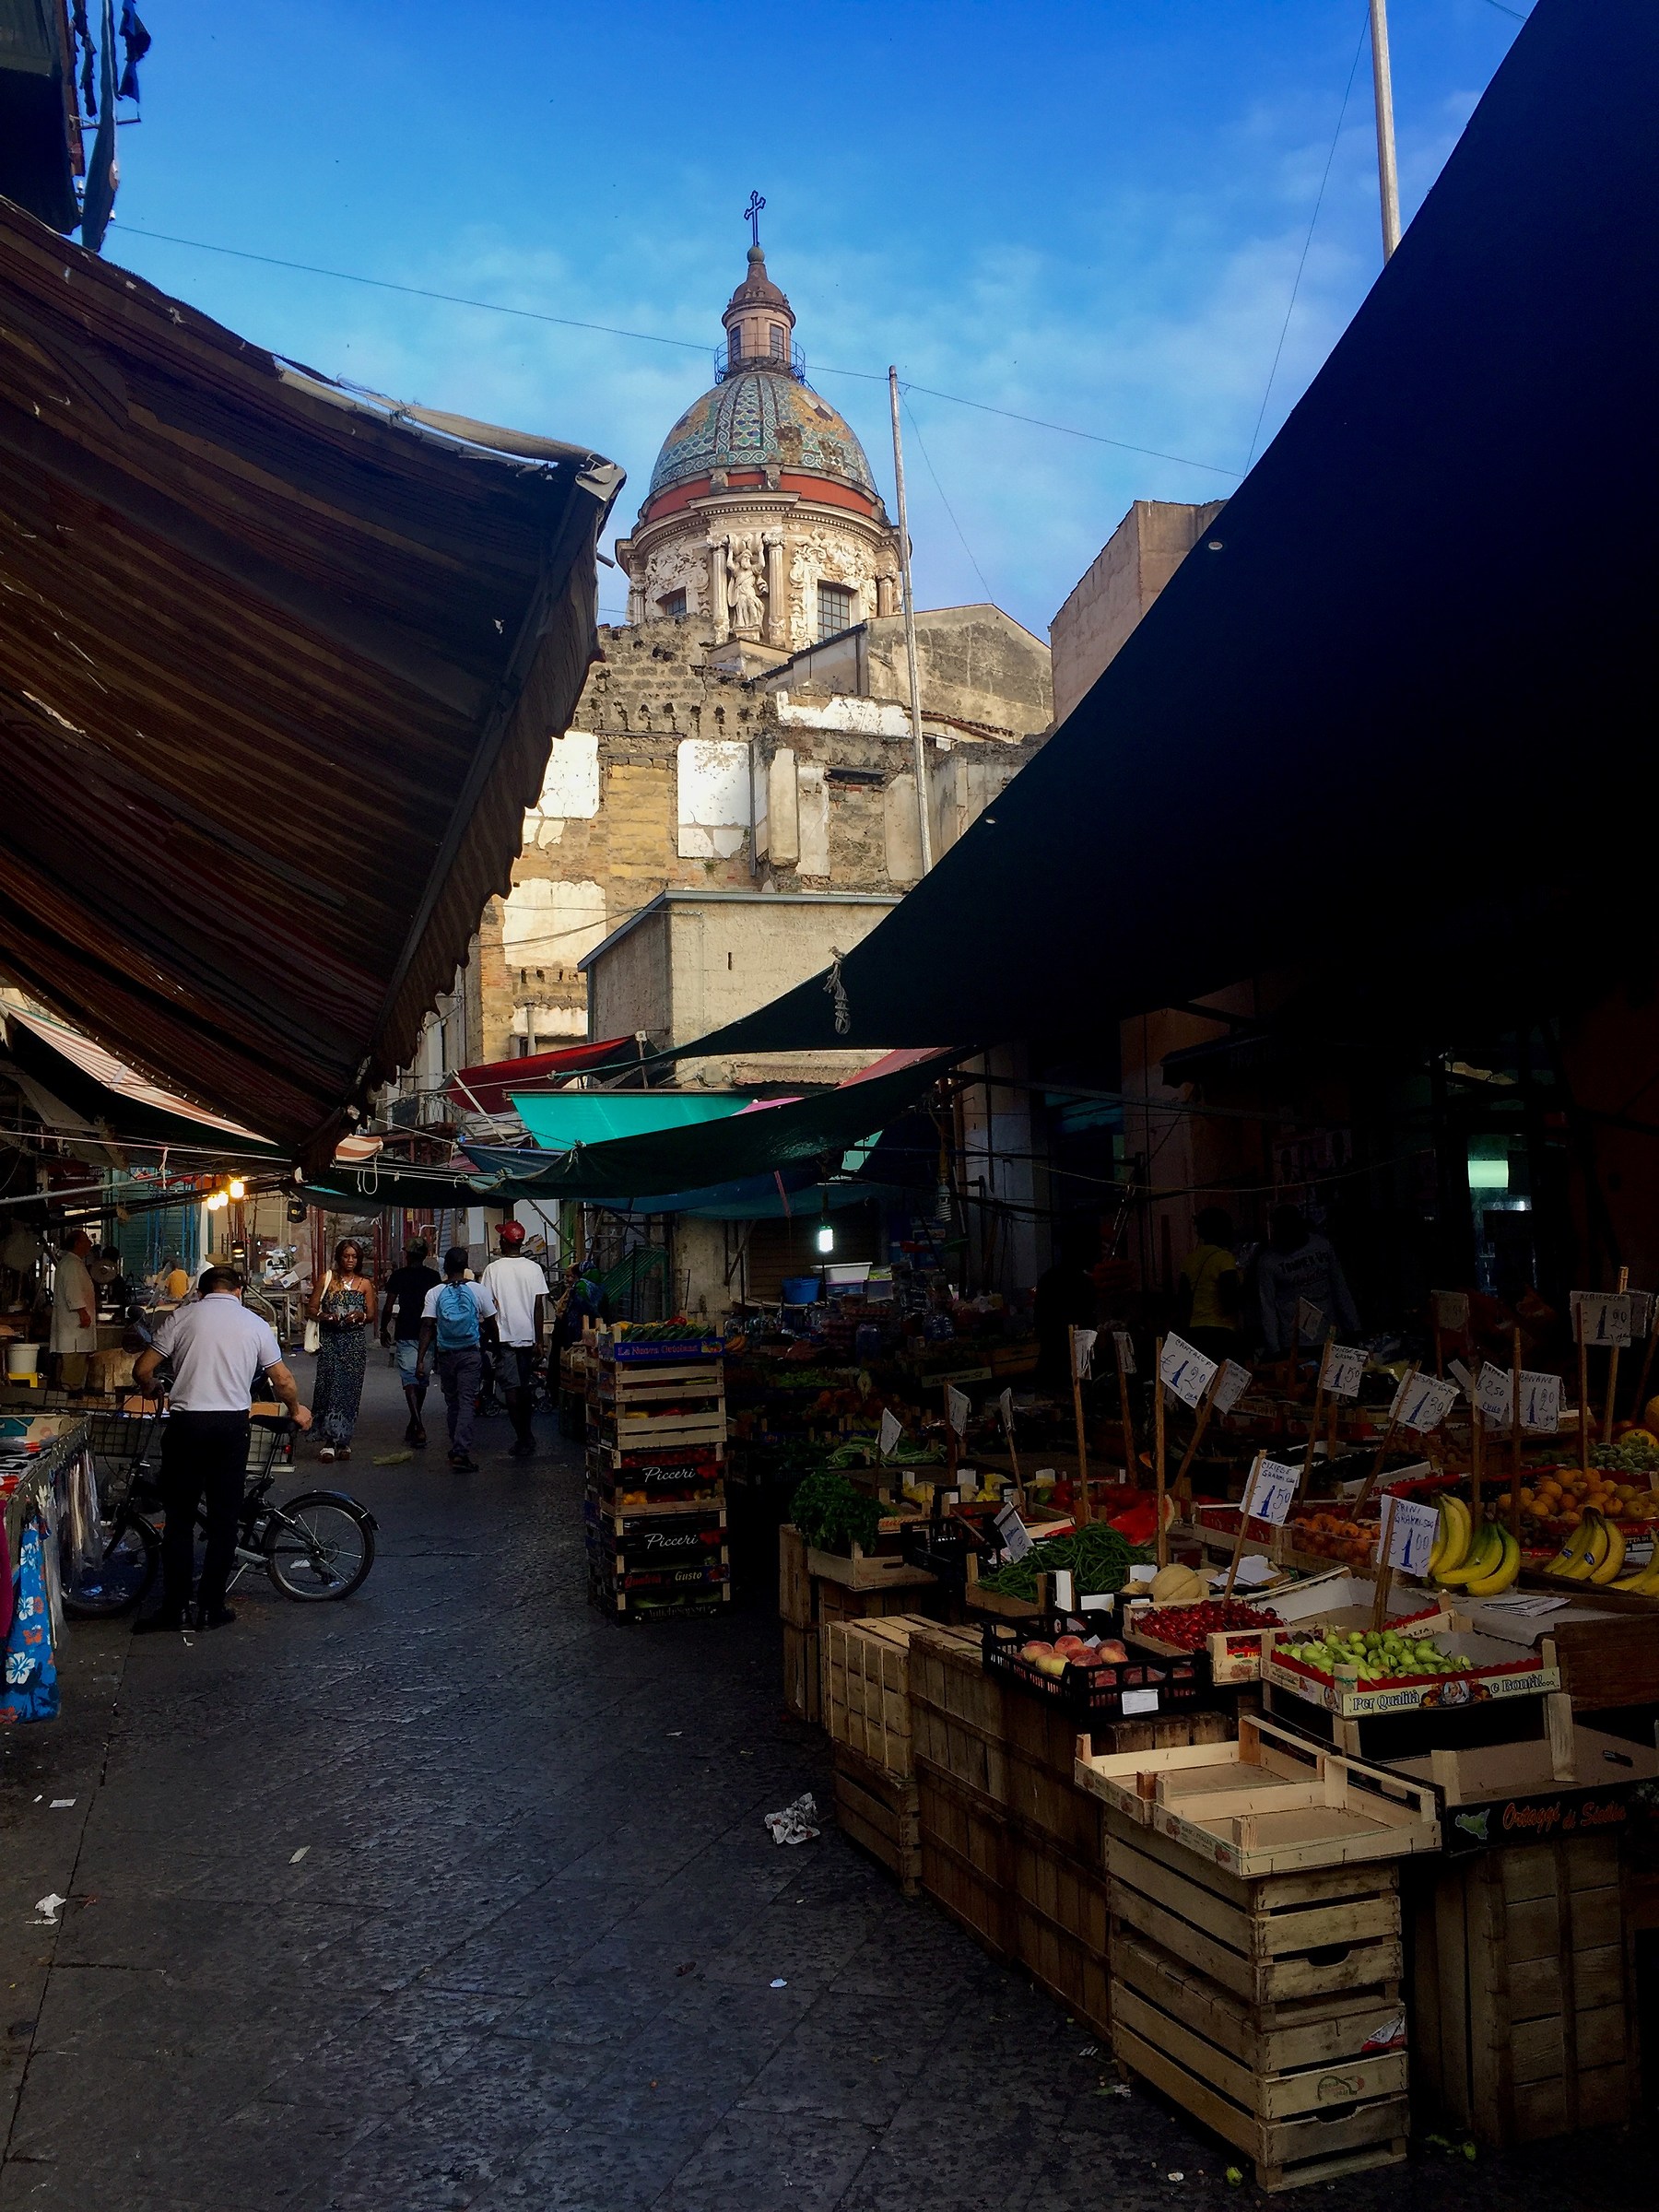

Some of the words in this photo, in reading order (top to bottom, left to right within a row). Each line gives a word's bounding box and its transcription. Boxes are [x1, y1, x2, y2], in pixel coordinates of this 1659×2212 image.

[642, 1466, 696, 1483] Picceri
[644, 1533, 699, 1550] Picceri
[675, 1571, 702, 1583] Gusto
[1352, 1694, 1375, 1712] Per
[1377, 1689, 1421, 1709] Qualità
[1491, 1683, 1500, 1693] e
